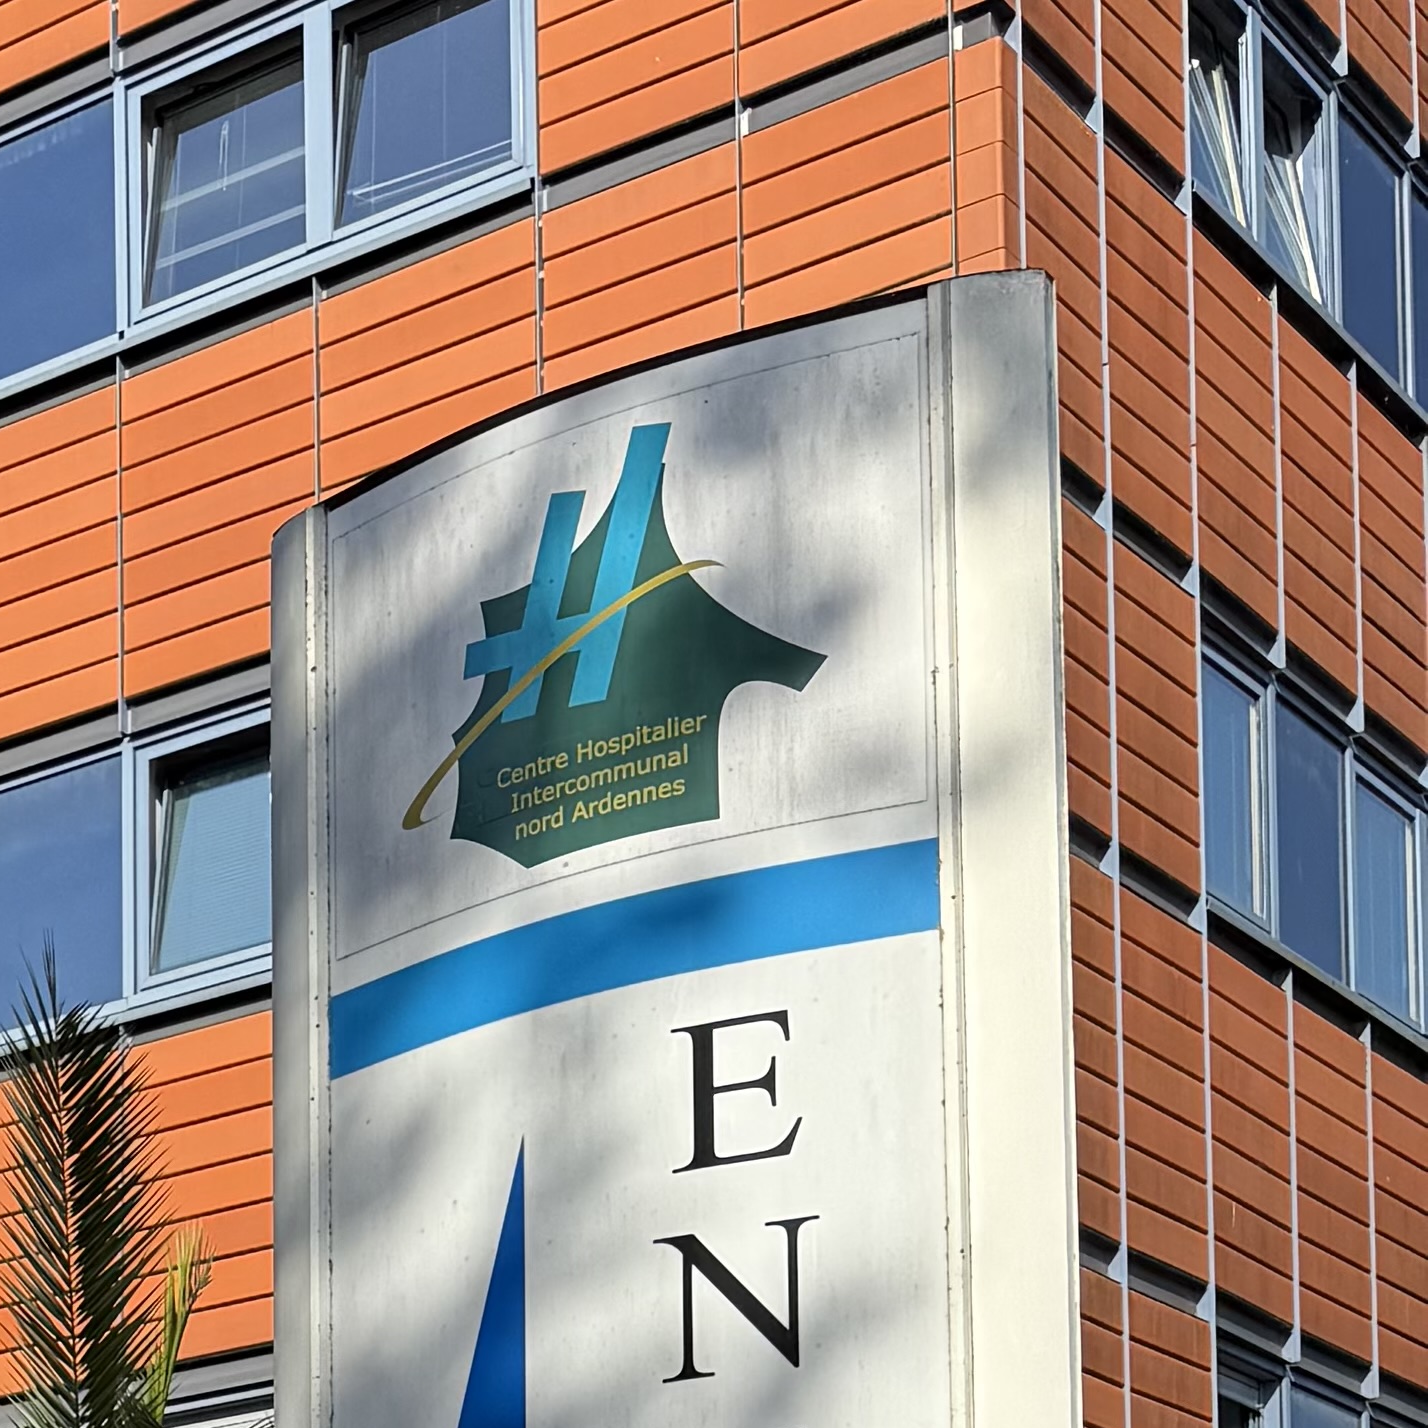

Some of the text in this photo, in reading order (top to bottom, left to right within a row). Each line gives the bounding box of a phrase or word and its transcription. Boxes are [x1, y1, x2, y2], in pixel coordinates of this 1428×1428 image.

[497, 714, 708, 788] Centre Hospitalier
[511, 743, 689, 814] Intercommunal
[515, 778, 686, 841] nord Ardennes
